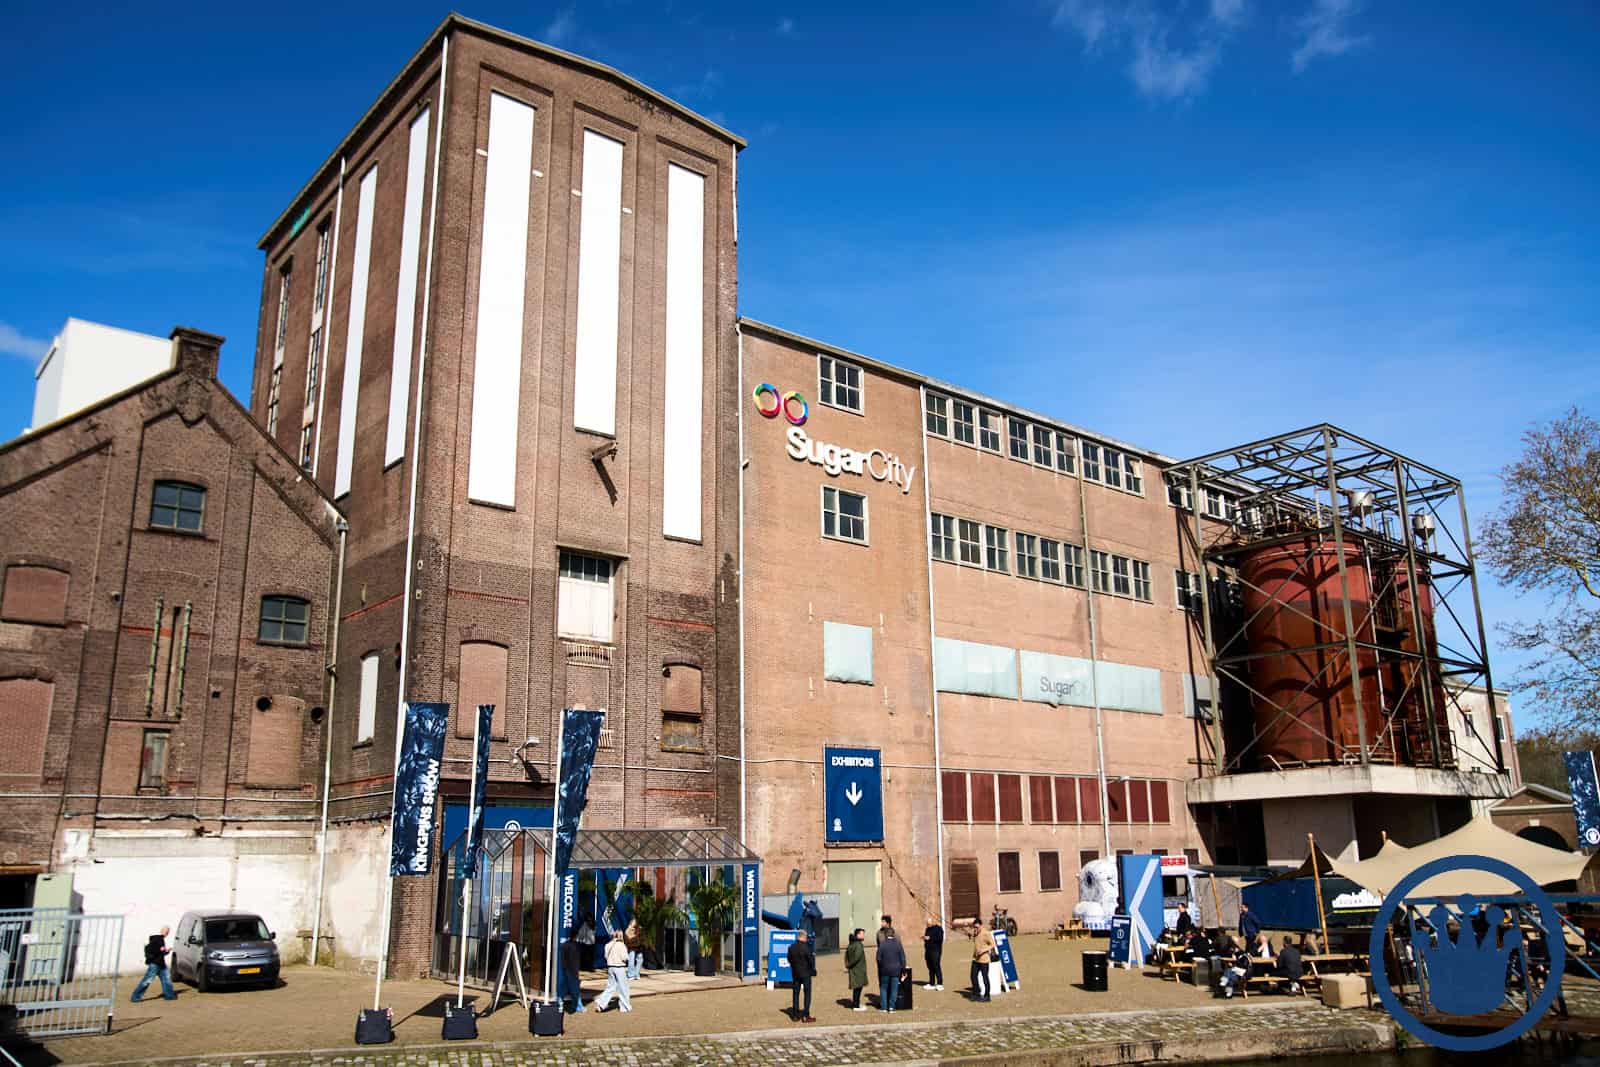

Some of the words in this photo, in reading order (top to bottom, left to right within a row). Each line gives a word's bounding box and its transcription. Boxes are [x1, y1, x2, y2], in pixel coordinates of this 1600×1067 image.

[786, 426, 915, 494] SugarCity
[422, 758, 440, 805] SHOW
[831, 756, 874, 767] EXHIBITORS
[416, 805, 433, 872] KINGPINS
[564, 874, 574, 929] WELCOME
[746, 870, 755, 919] WELCOME
